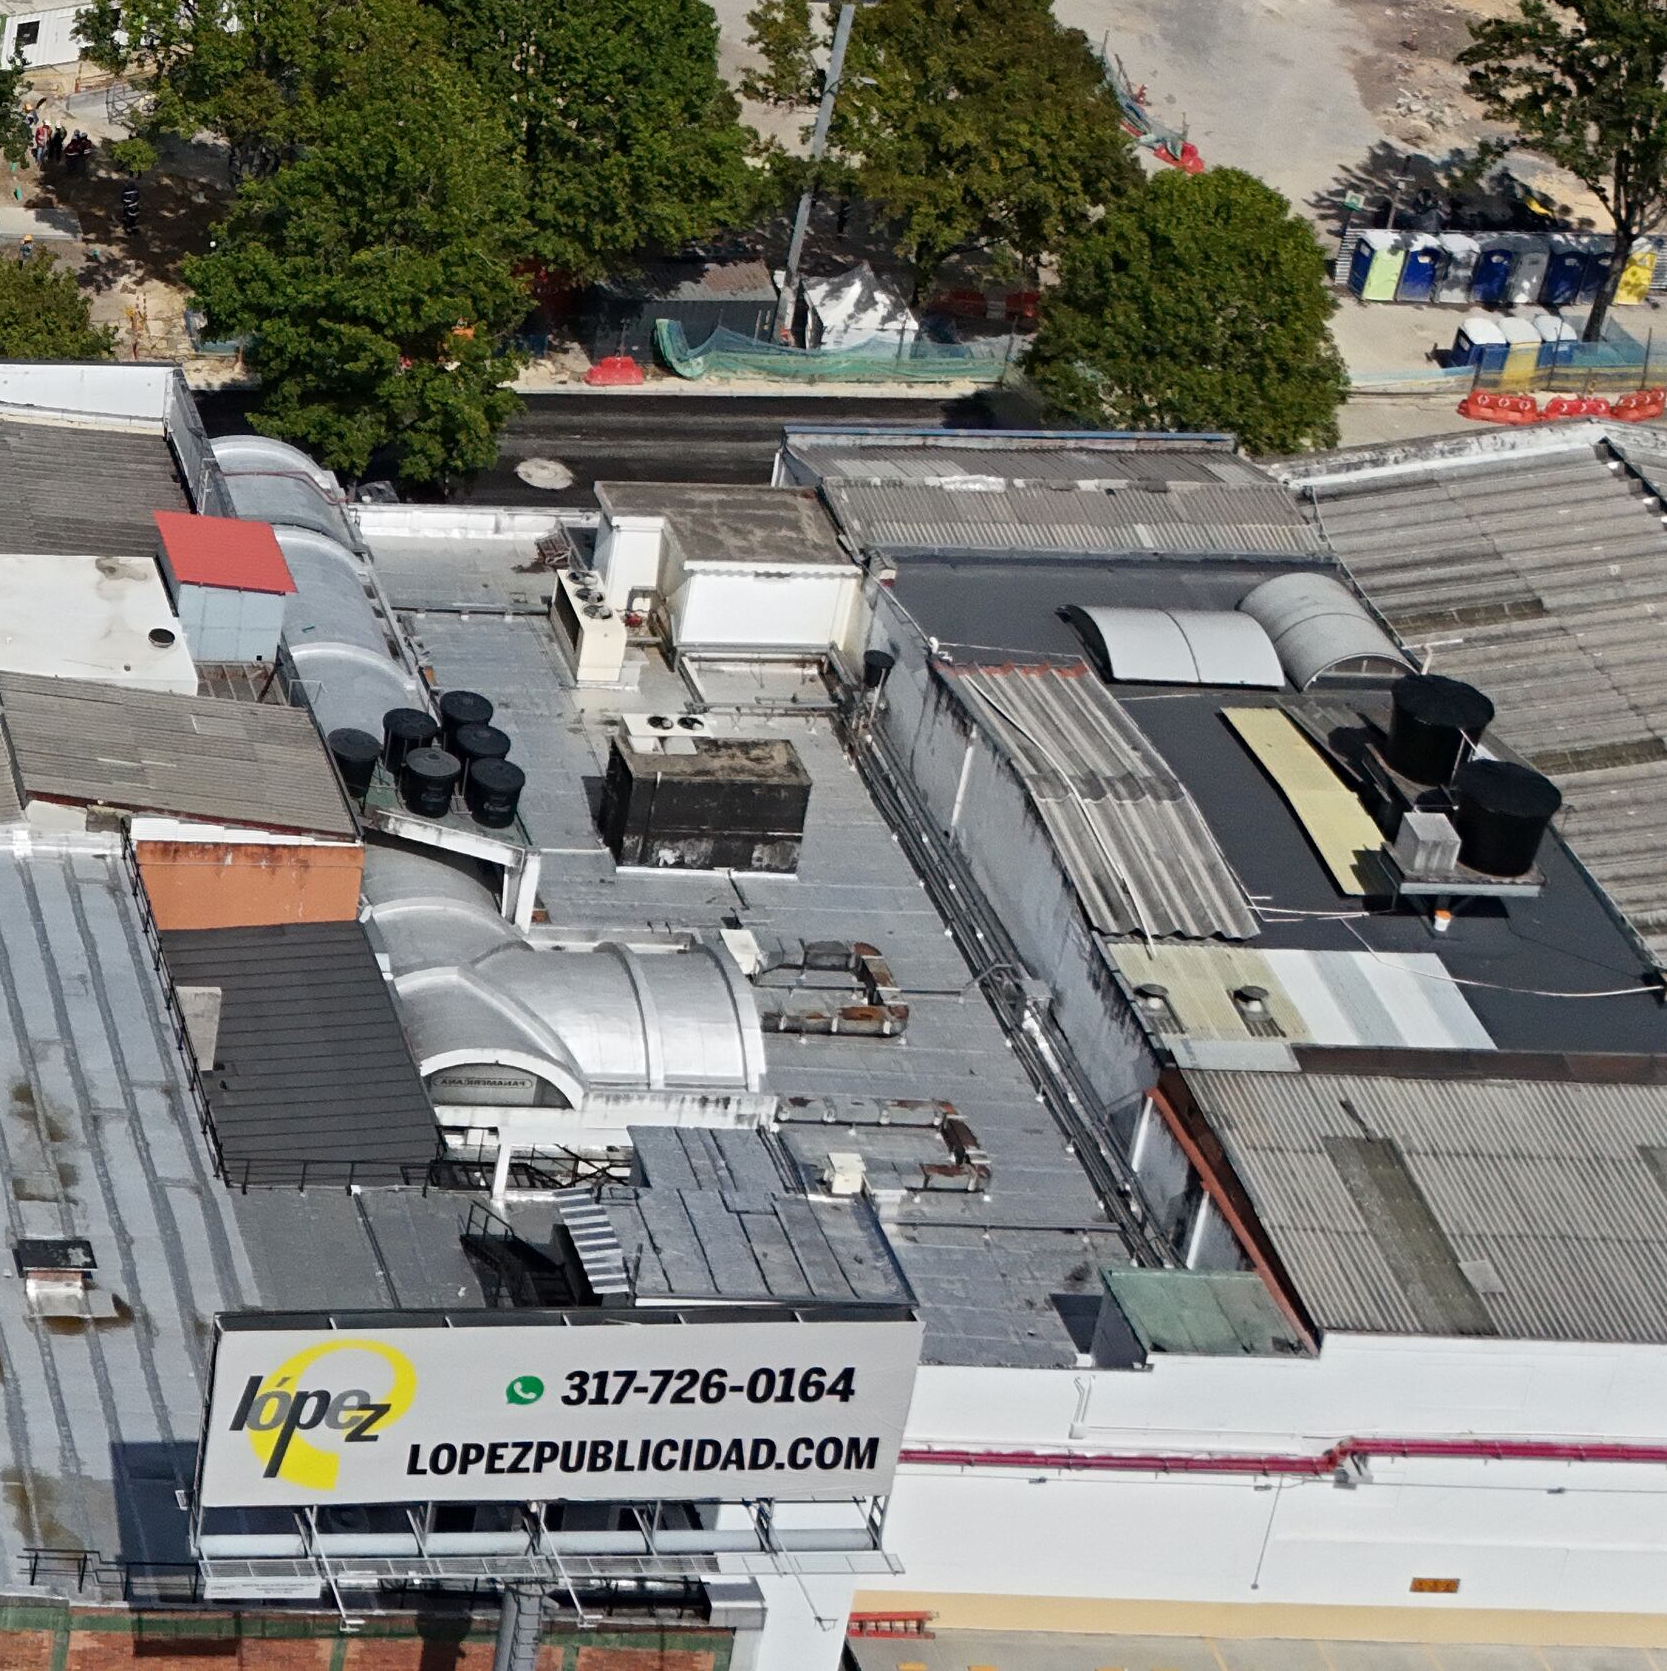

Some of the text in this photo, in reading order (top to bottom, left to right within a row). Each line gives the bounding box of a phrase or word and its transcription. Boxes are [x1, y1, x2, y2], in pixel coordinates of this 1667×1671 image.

[561, 1366, 856, 1405] 317-726-0164
[229, 1374, 391, 1478] lópez
[406, 1435, 880, 1476] LOPEZPUBLICIDAD.COM
